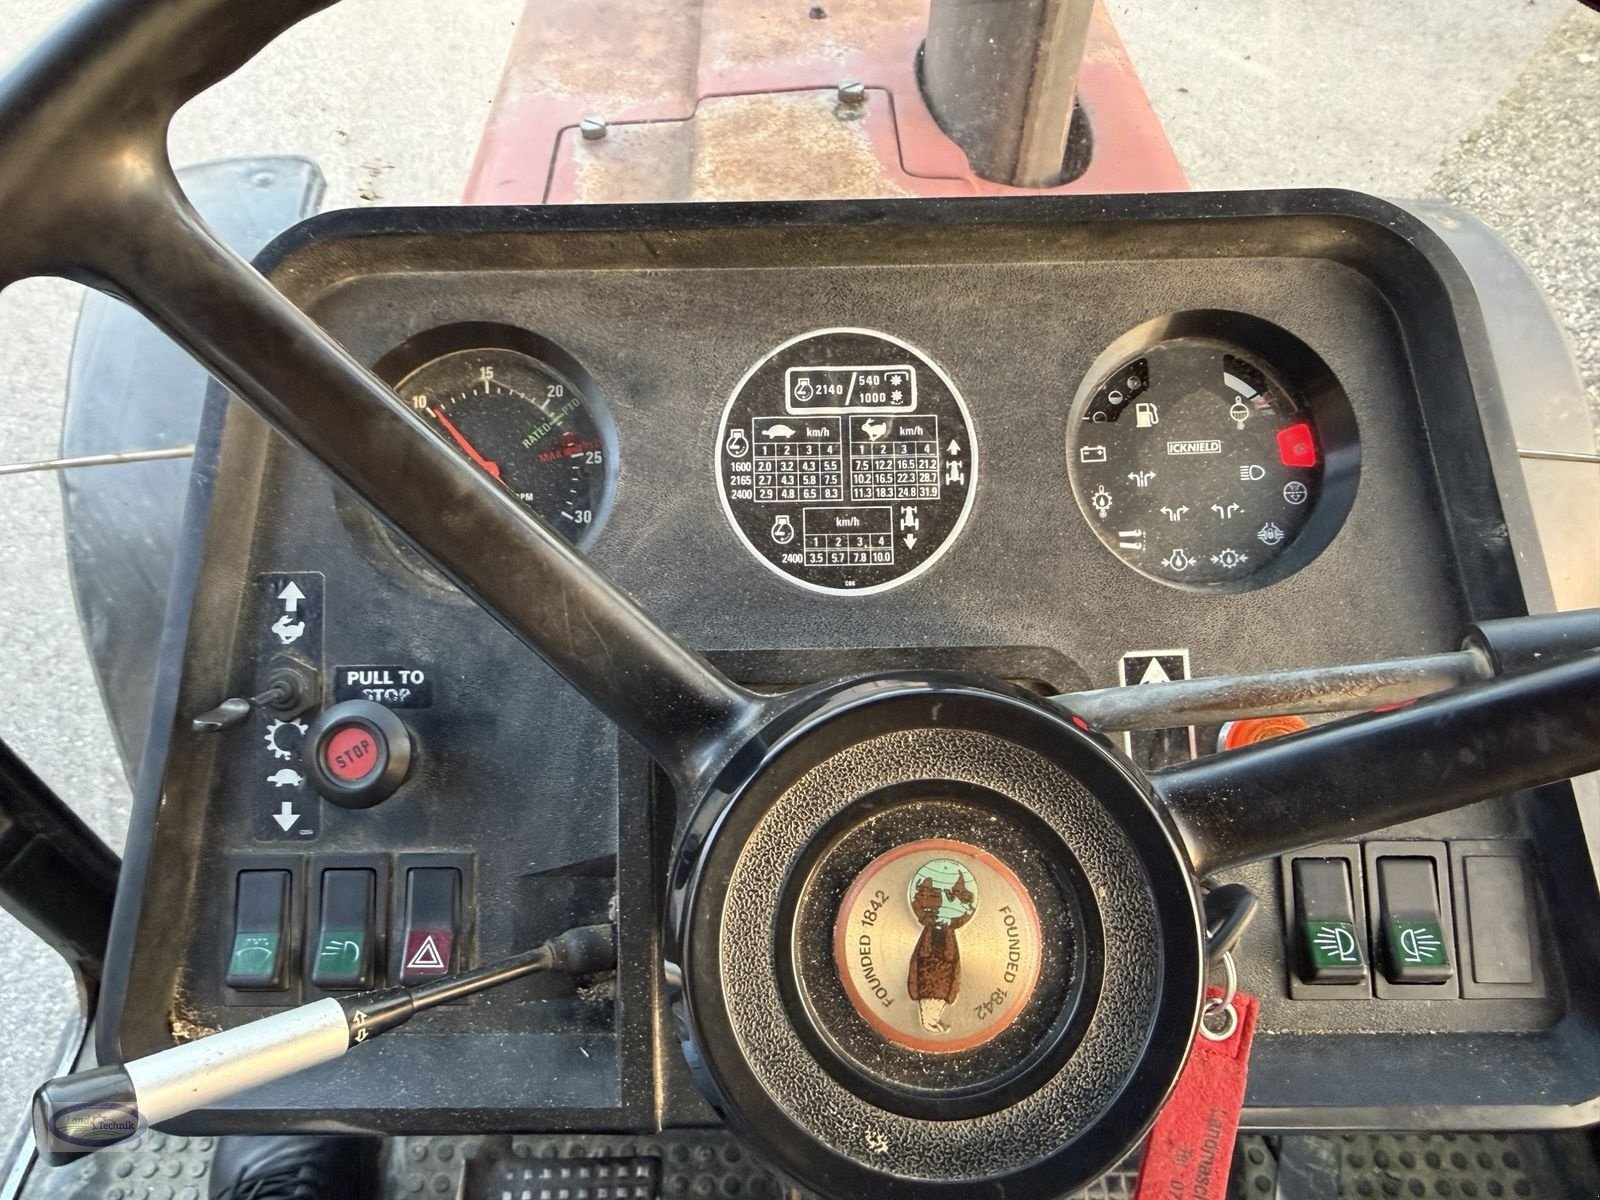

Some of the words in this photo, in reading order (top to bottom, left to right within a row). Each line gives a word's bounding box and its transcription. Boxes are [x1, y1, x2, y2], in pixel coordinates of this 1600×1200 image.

[479, 366, 494, 380] 15
[858, 375, 880, 386] 540
[547, 384, 564, 397] 20
[815, 384, 843, 395] 2140
[412, 395, 428, 409] 10
[860, 392, 886, 403] 1000
[521, 422, 552, 449] RATED
[561, 398, 581, 415] PTO
[806, 427, 830, 437] km/h
[899, 426, 924, 436] km/h
[762, 446, 767, 455] 1
[784, 445, 790, 455] 2
[806, 445, 812, 454] 3
[826, 445, 833, 454] 4
[859, 445, 864, 454] 1
[880, 445, 886, 454] 2
[901, 444, 907, 453] 3
[924, 443, 930, 453] 4
[1169, 442, 1219, 453] ICKNIELD
[585, 450, 603, 465] 25
[731, 462, 752, 471] 1600
[758, 462, 772, 471] 2.0
[780, 462, 794, 471] 3.2
[802, 461, 816, 471] 4.3
[824, 461, 837, 470] 5.5
[855, 461, 869, 470] 7.5
[875, 460, 893, 470] 12.2
[897, 460, 915, 469] 16.5
[918, 459, 937, 469] 21.2
[730, 476, 752, 485] 2165
[758, 475, 772, 485] 2.7
[780, 475, 794, 485] 4.3
[803, 475, 816, 484] 5.8
[824, 475, 837, 484] 7.5
[854, 474, 872, 484] 10.2
[875, 474, 893, 483] 16.5
[897, 473, 915, 483] 22.3
[919, 473, 937, 482] 28.7
[731, 489, 753, 499] 2400
[759, 489, 773, 499] 2.9
[781, 489, 795, 498] 4.8
[803, 489, 817, 498] 6.5
[825, 488, 838, 498] 8.3
[854, 488, 872, 498] 11.3
[876, 488, 894, 497] 18.3
[898, 488, 916, 497] 24.8
[919, 487, 938, 496] 31.9
[574, 510, 592, 524] 30
[836, 517, 860, 527] km/h
[814, 537, 818, 547] 1
[835, 537, 841, 546] 2
[857, 537, 863, 546] 3
[878, 536, 884, 546] 4
[782, 554, 803, 563] 2400
[809, 553, 824, 563] 3.5
[831, 553, 845, 563] 5.7
[853, 553, 867, 562] 7.8
[873, 552, 891, 562] 10.0
[347, 670, 394, 685] PULL
[399, 670, 425, 684] TO
[335, 740, 370, 768] STOP
[861, 889, 890, 928] 1842
[998, 905, 1021, 984] FOUNDED
[859, 934, 895, 1008] FOUNDED
[974, 986, 1008, 1020] 1842
